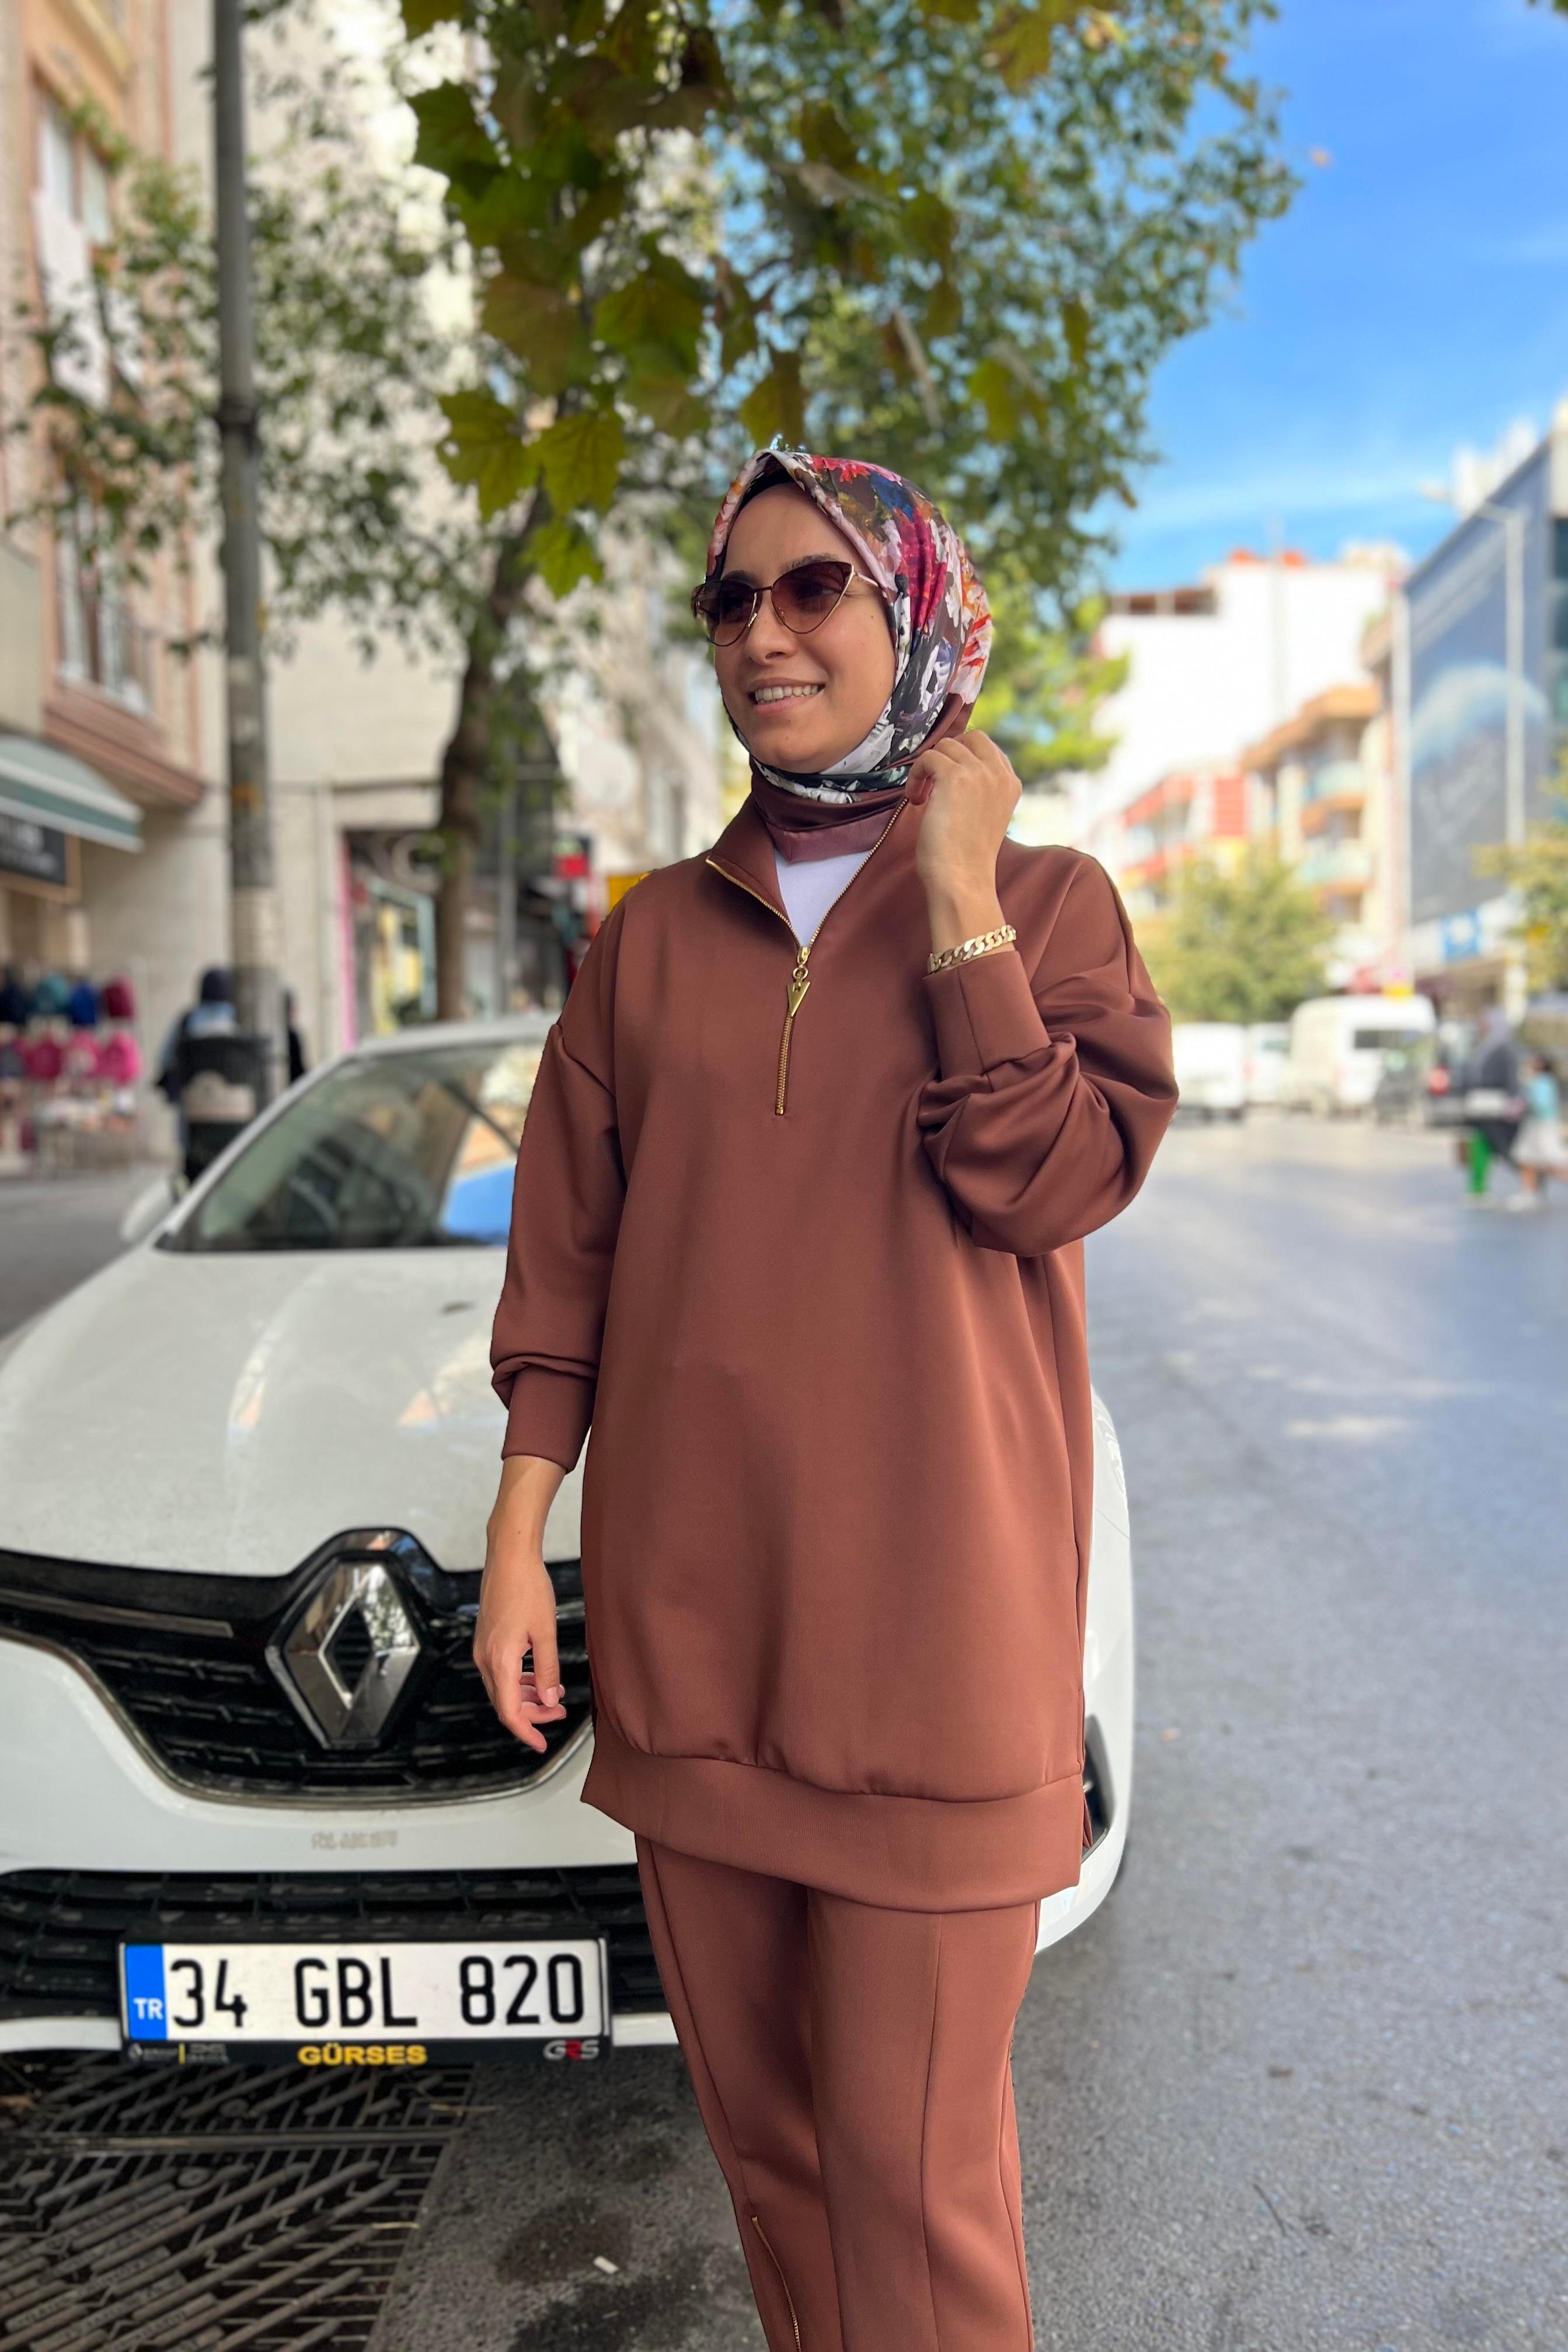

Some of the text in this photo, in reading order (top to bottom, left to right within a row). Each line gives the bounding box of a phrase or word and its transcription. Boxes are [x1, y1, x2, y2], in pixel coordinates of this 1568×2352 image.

[170, 1953, 584, 2027] 34 GBL 820
[134, 1998, 163, 2020] TR
[298, 2043, 427, 2065] GÜRSES
[543, 2039, 599, 2061] GRS
